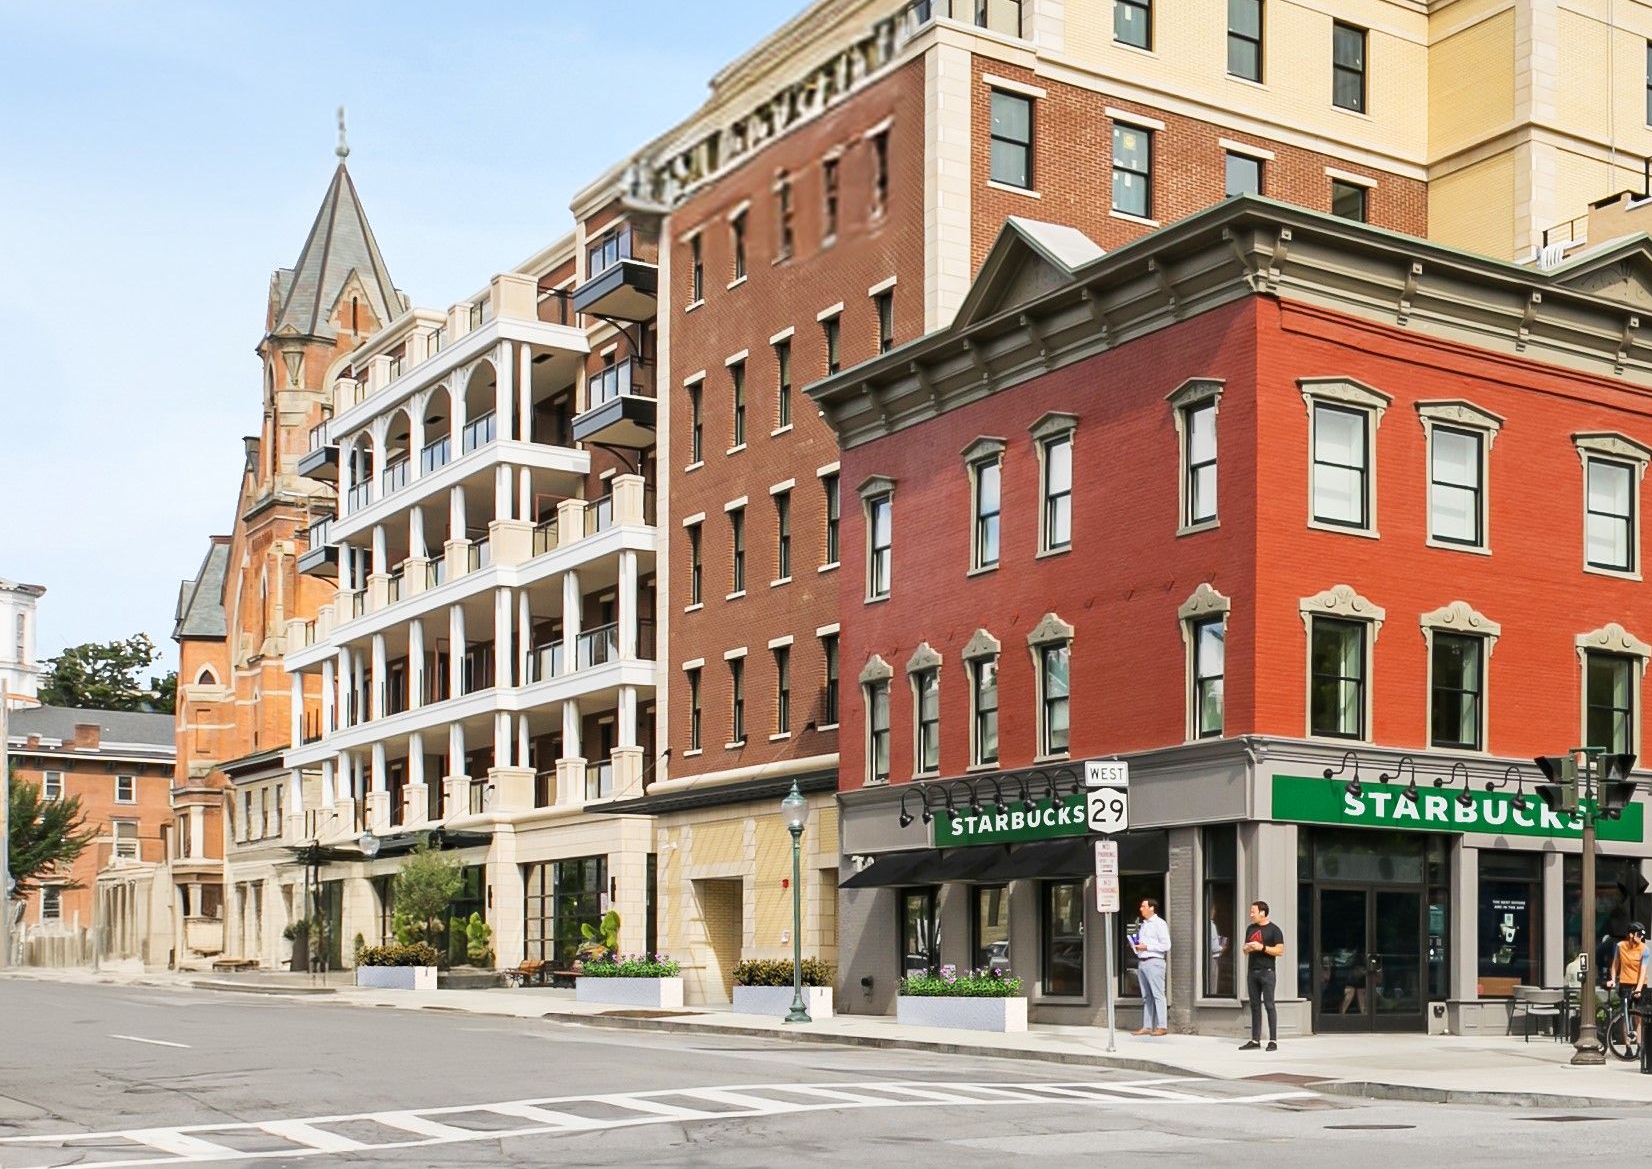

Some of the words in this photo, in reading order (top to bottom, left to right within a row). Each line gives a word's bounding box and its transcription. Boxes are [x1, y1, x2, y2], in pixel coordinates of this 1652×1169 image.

[1090, 767, 1124, 780] WEST
[951, 805, 1085, 836] STARBUCKS
[1091, 798, 1124, 823] 29
[1343, 791, 1588, 831] STARBUCKS
